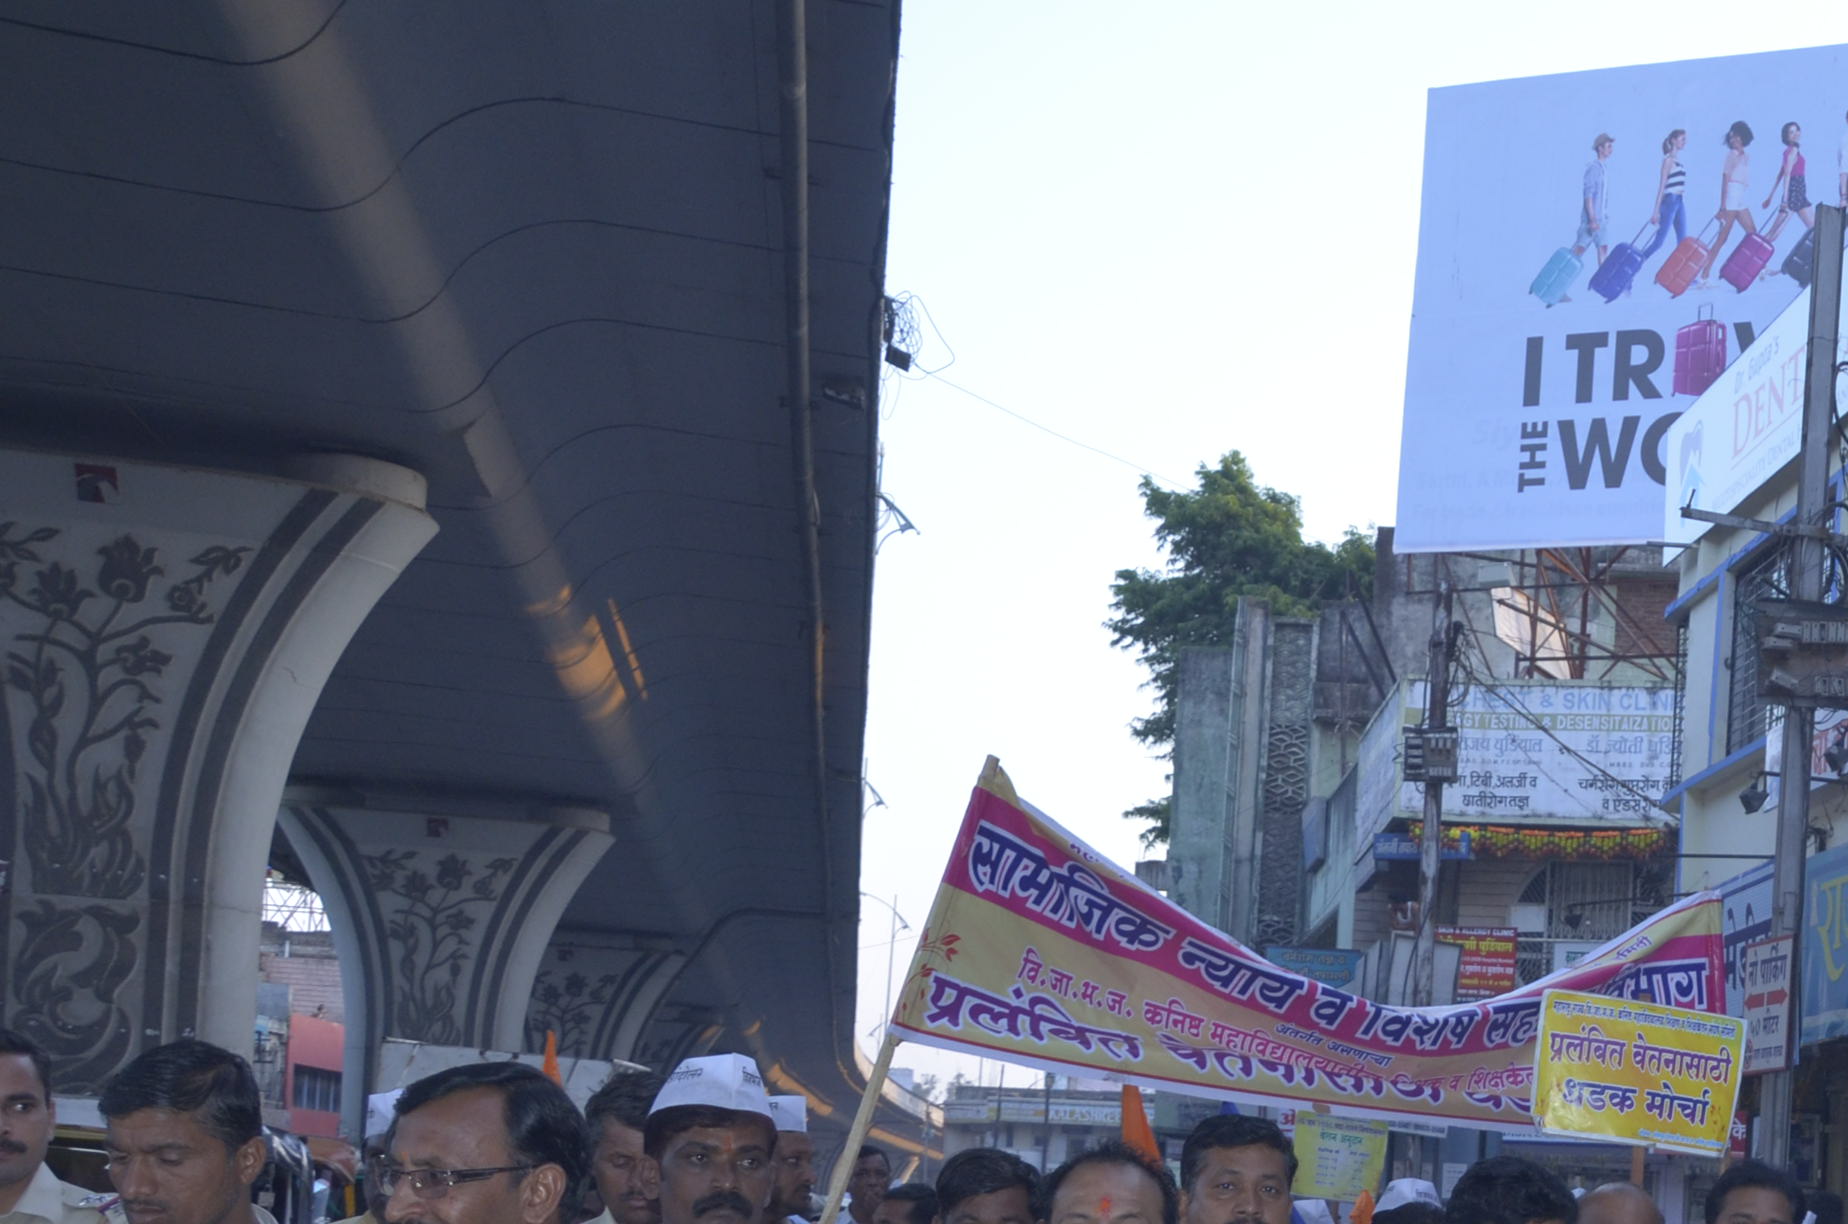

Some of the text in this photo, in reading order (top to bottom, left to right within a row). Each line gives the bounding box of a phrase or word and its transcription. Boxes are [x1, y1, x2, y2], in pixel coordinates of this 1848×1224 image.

[1731, 342, 1807, 460] DENT
[1517, 420, 1549, 493] THE
[1557, 715, 1674, 731] DESENSITAIZATIO
[1562, 691, 1611, 711] SKIN
[1619, 692, 1675, 712] CLINI
[970, 822, 1174, 952] सामाजिक
[1180, 938, 1306, 1015] न्याय
[1312, 985, 1356, 1029] व
[1143, 998, 1205, 1039] कनिष्ठ
[1549, 1026, 1732, 1084] प्रलंबित वेतनासाठी
[1563, 1078, 1638, 1114] धडक
[1645, 1082, 1711, 1126] मोर्चा
